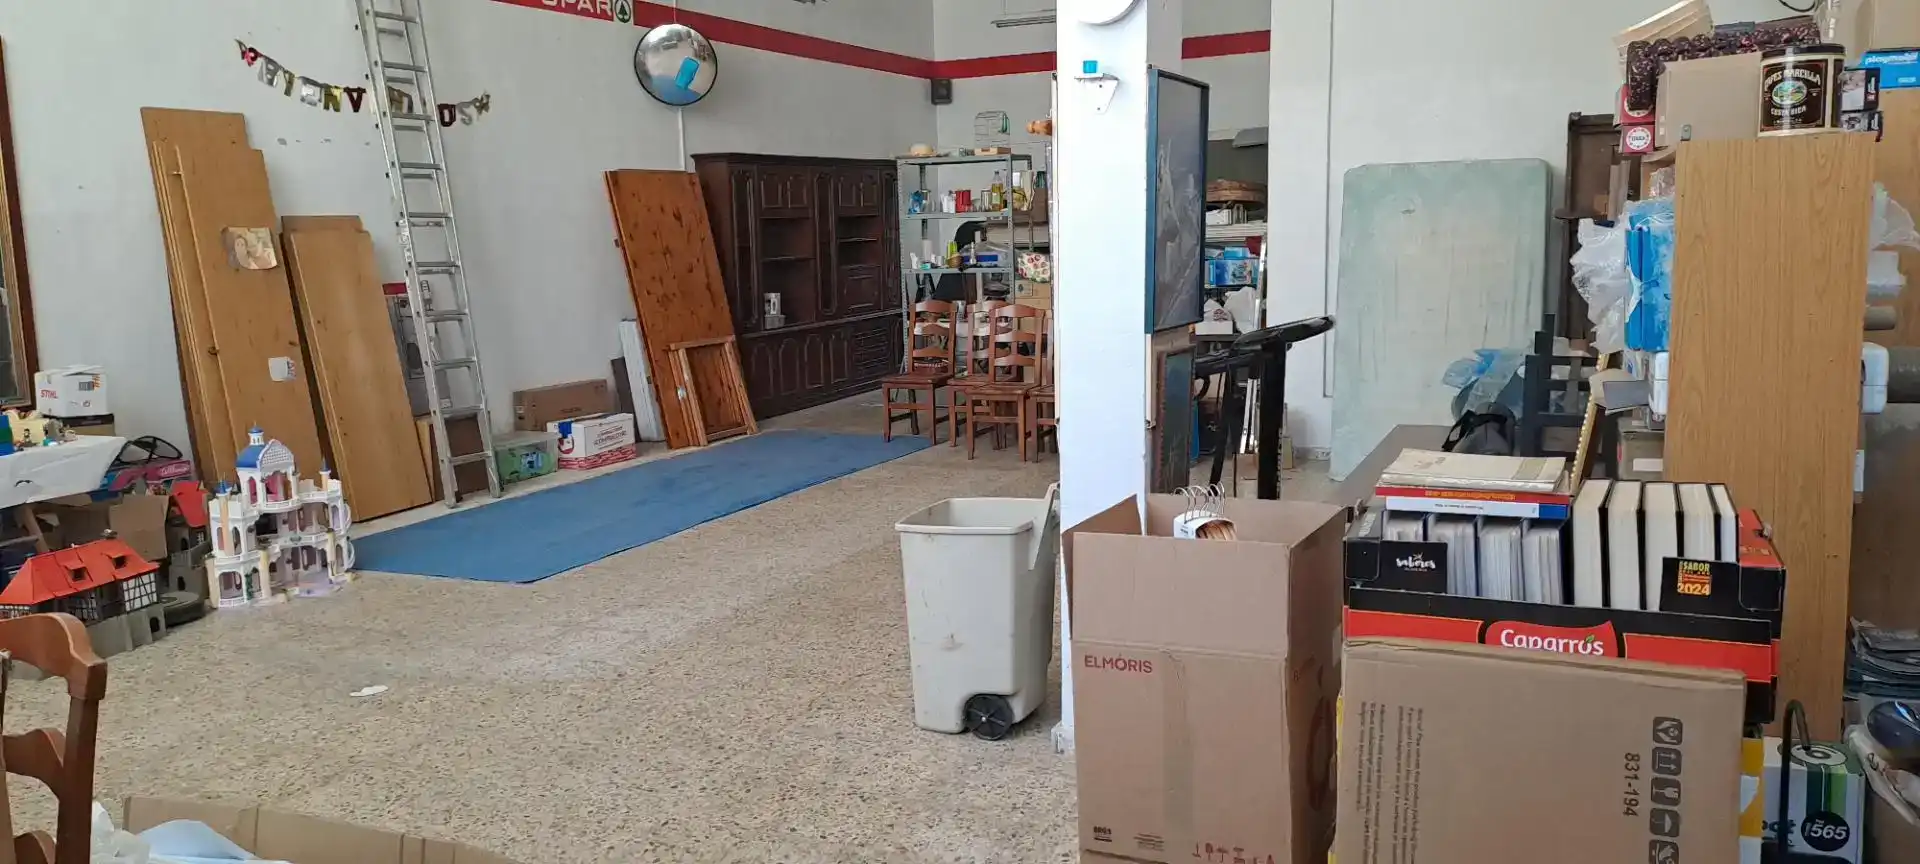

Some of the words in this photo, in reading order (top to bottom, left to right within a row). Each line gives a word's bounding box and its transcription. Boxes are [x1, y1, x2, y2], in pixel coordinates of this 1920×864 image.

[1783, 68, 1821, 86] MARCILLA
[1771, 107, 1790, 117] COSTA
[1790, 105, 1807, 115] RICA
[41, 389, 58, 399] STIHL
[1683, 561, 1710, 572] SABOR
[1677, 583, 1711, 595] 2024
[1622, 752, 1640, 817] 831-194
